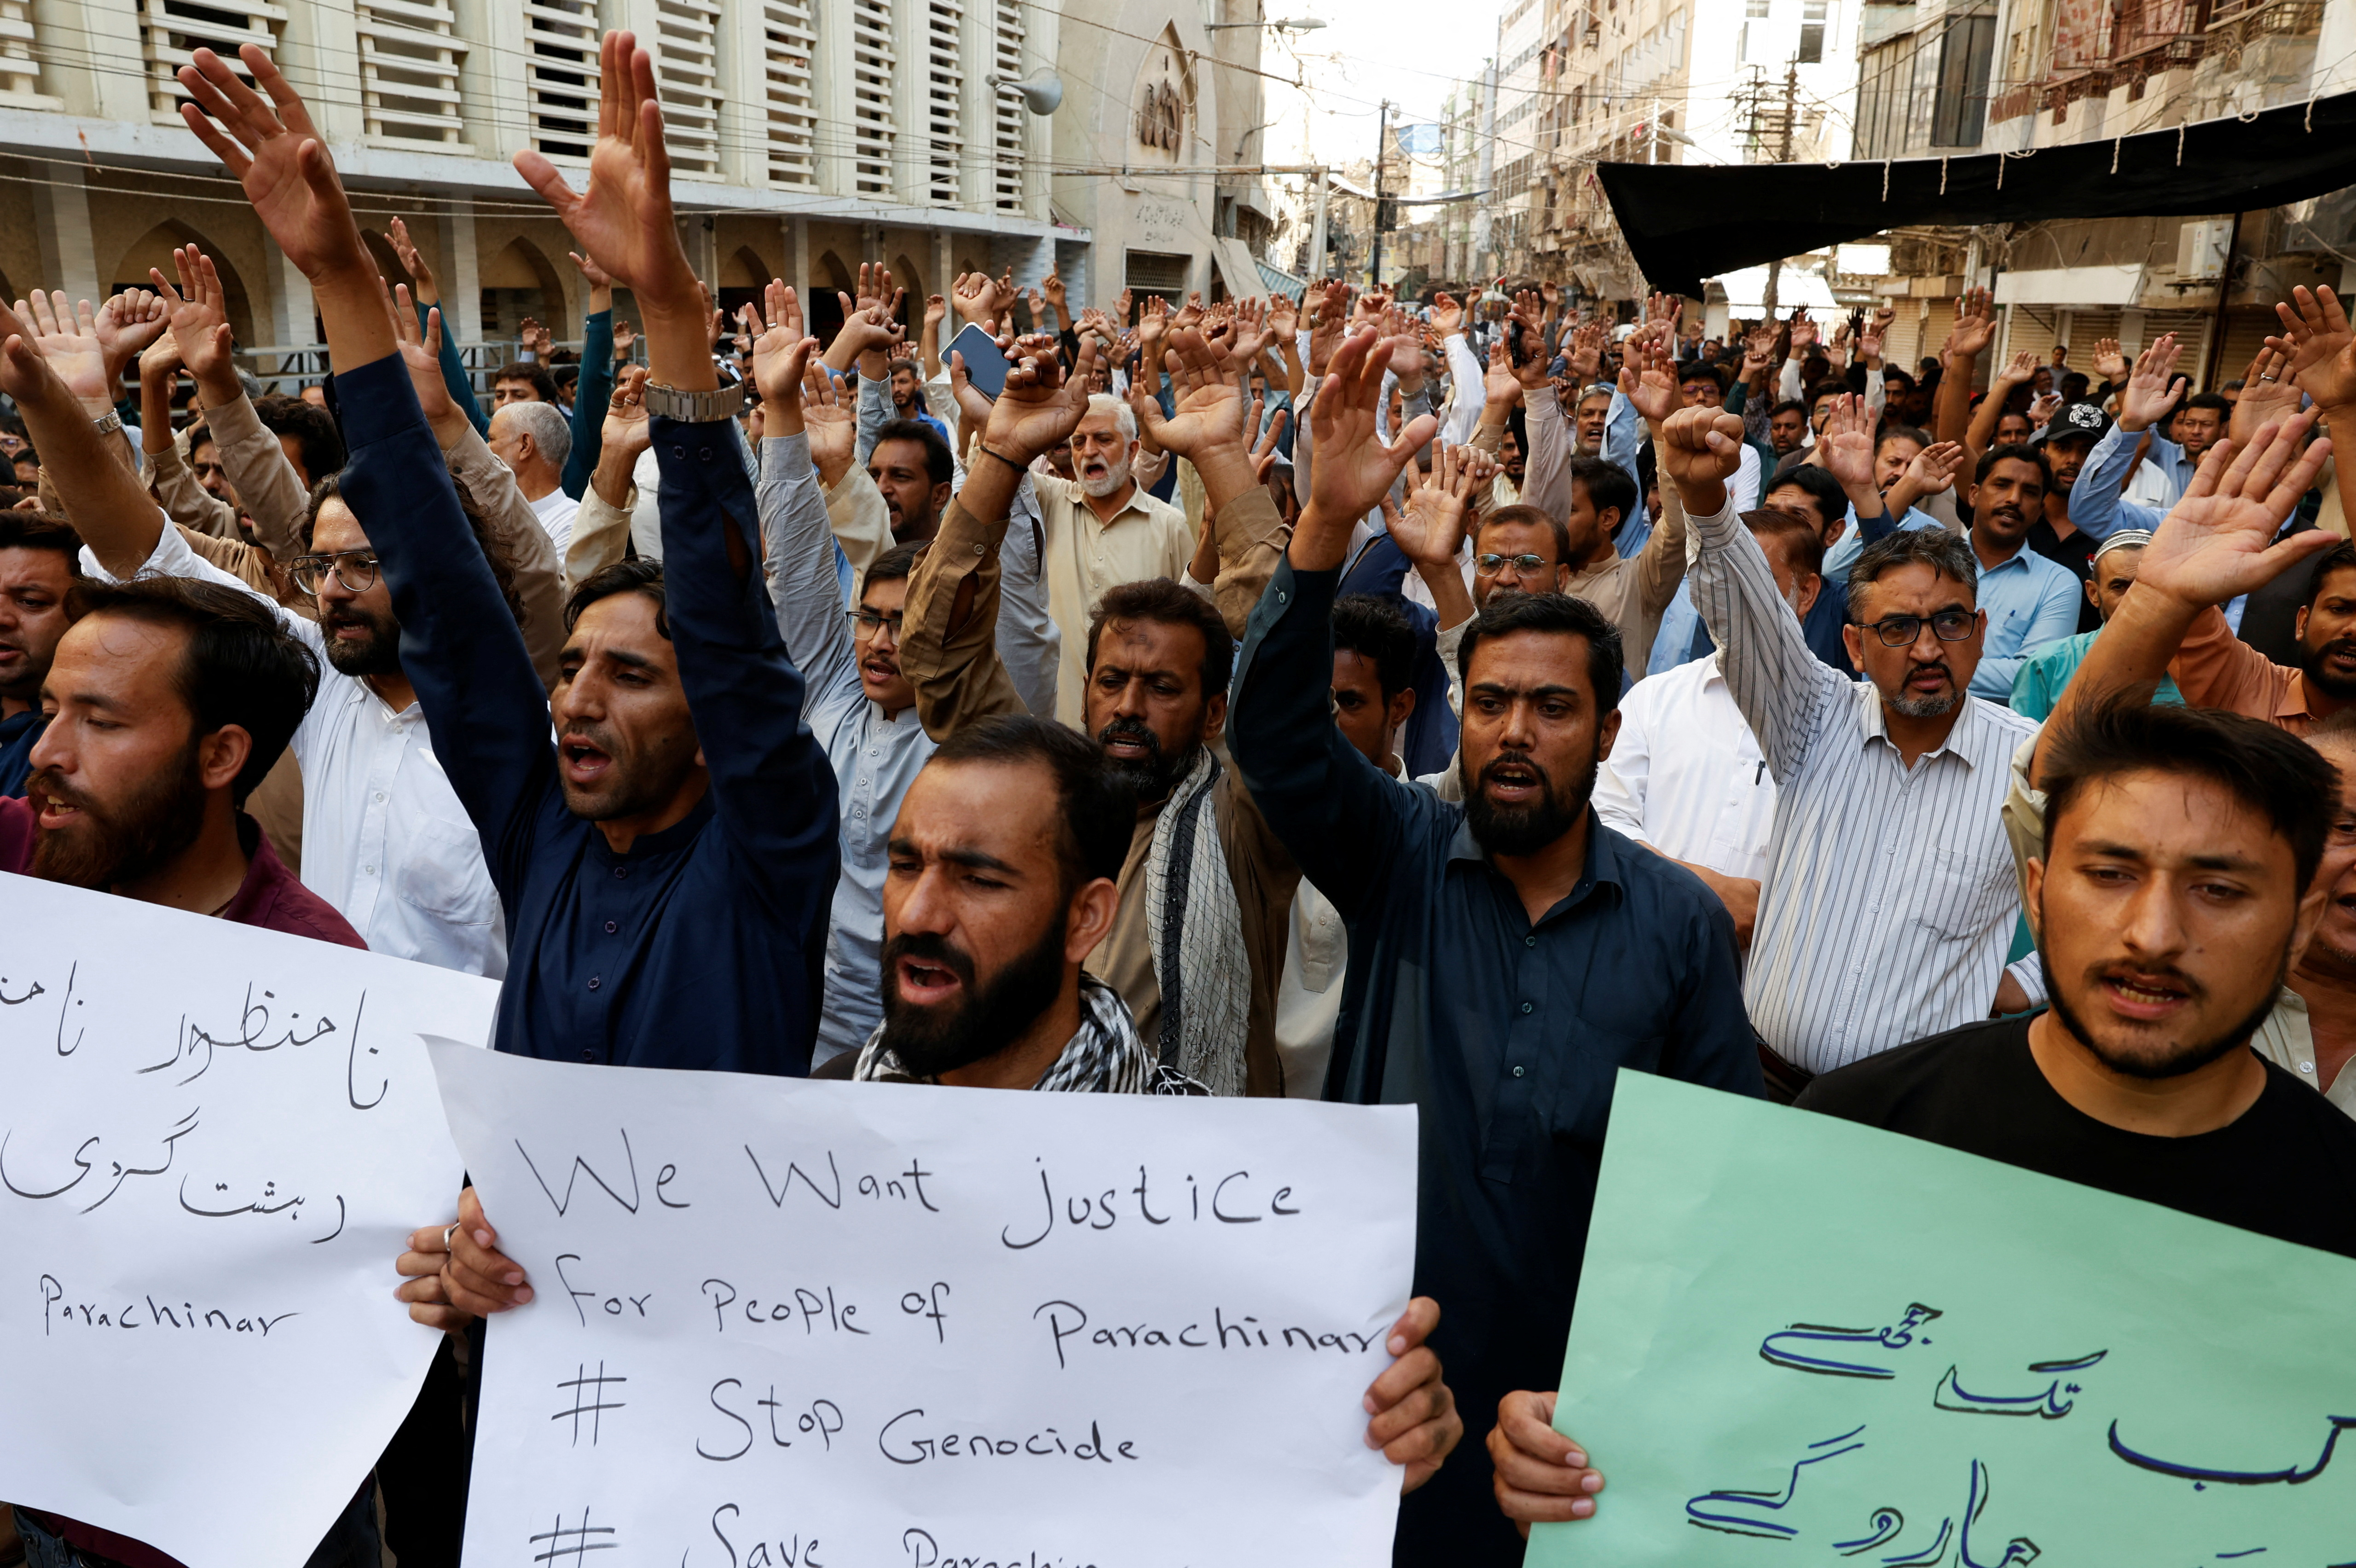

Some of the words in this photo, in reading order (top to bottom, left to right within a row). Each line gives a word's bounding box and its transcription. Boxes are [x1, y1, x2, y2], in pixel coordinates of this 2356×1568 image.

[515, 1128, 690, 1217] We
[745, 1145, 939, 1212] Want
[40, 1274, 299, 1337] Parachinar
[901, 1282, 950, 1343] of
[1033, 1300, 1386, 1369] Parachinar
[879, 1409, 1138, 1464] Genocide
